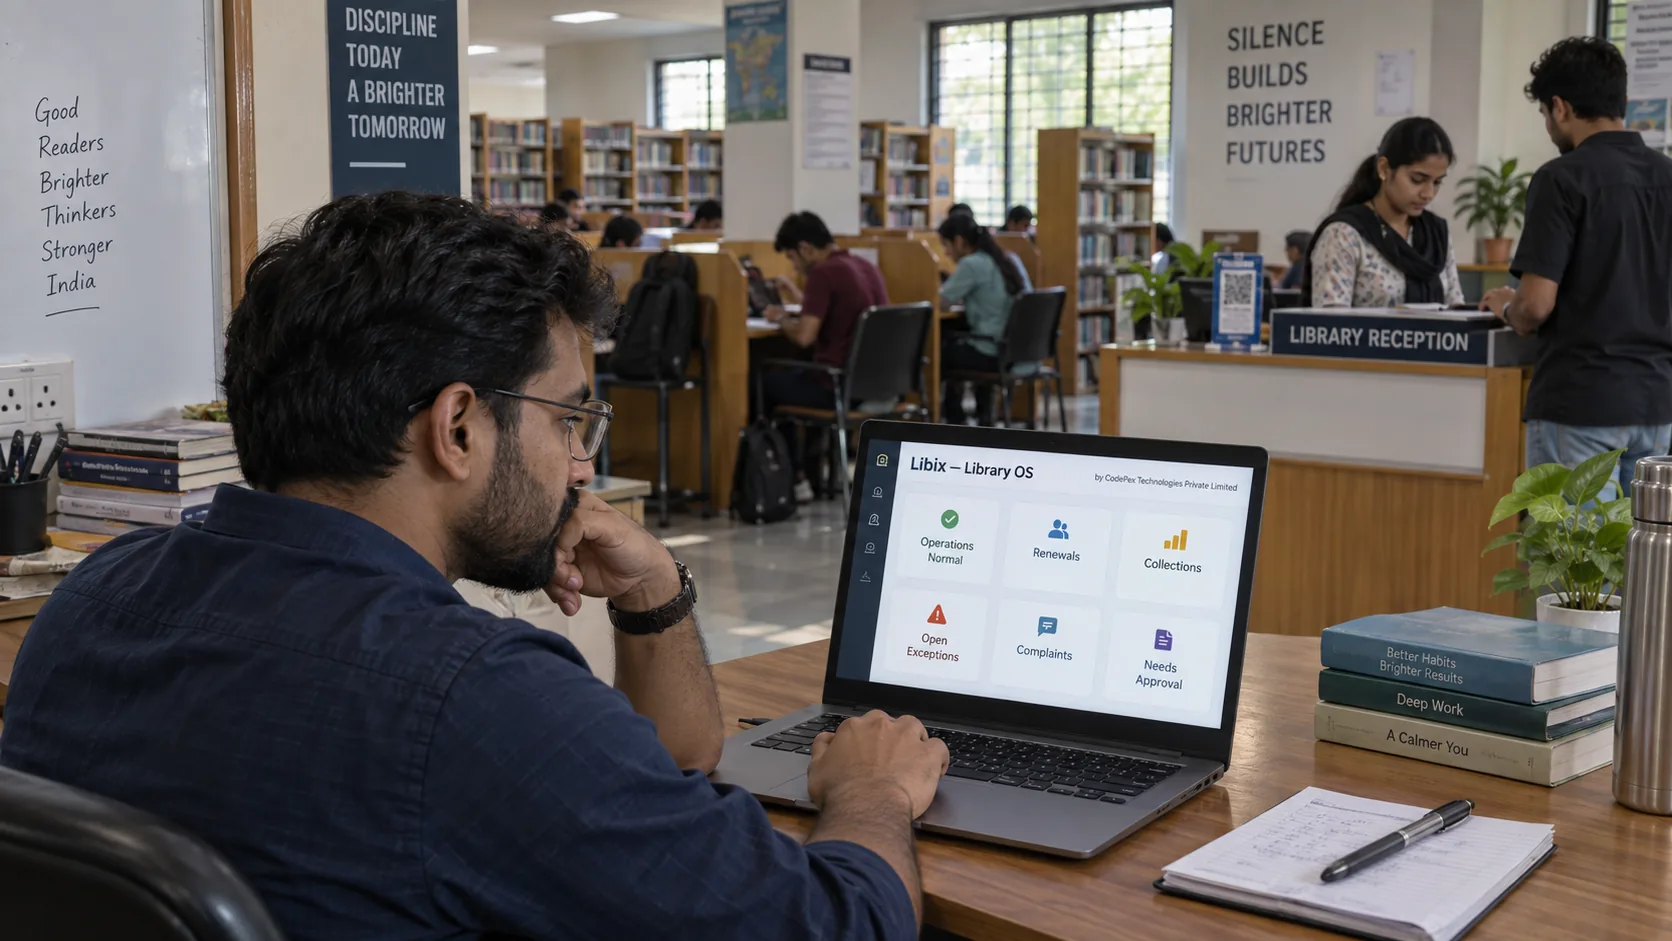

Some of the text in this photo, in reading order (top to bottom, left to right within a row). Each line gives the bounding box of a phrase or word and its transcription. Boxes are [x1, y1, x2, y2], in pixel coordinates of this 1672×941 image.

[346, 7, 437, 38] DISCIPLINE
[1227, 20, 1325, 52] SILENCE
[346, 43, 402, 70] TODAY
[1227, 61, 1308, 89] BUILDS
[347, 79, 445, 107] A BRIGHTER
[35, 96, 79, 127] Good
[1227, 100, 1332, 127] BRIGHTER
[348, 114, 446, 141] TOMORROW
[38, 132, 104, 158] Readers
[1226, 139, 1326, 165] FUTURES
[40, 169, 109, 199] Brighter
[41, 202, 117, 228] Thinkers
[42, 237, 113, 265] Stronger
[46, 272, 96, 297] India
[1290, 325, 1469, 351] LIBRARY RECEPTION
[910, 456, 947, 474] Libix
[964, 461, 1011, 480] Library
[1014, 464, 1034, 479] OS
[1094, 473, 1238, 491] by CodePex Technologies Private Limited
[920, 536, 974, 552] Operations
[1033, 547, 1081, 562] Renewals
[928, 552, 963, 565] Normal
[1144, 558, 1202, 573] Collections
[921, 633, 948, 647] Open
[1016, 644, 1073, 661] Complaints
[906, 646, 959, 662] Exceptions
[1144, 659, 1177, 674] Needs
[1387, 647, 1457, 669] Better Habits
[1136, 674, 1183, 690] Approval
[1379, 660, 1464, 685] Brighter Results
[1396, 693, 1464, 716] Deep Work
[1386, 730, 1469, 756] A Calmer You
